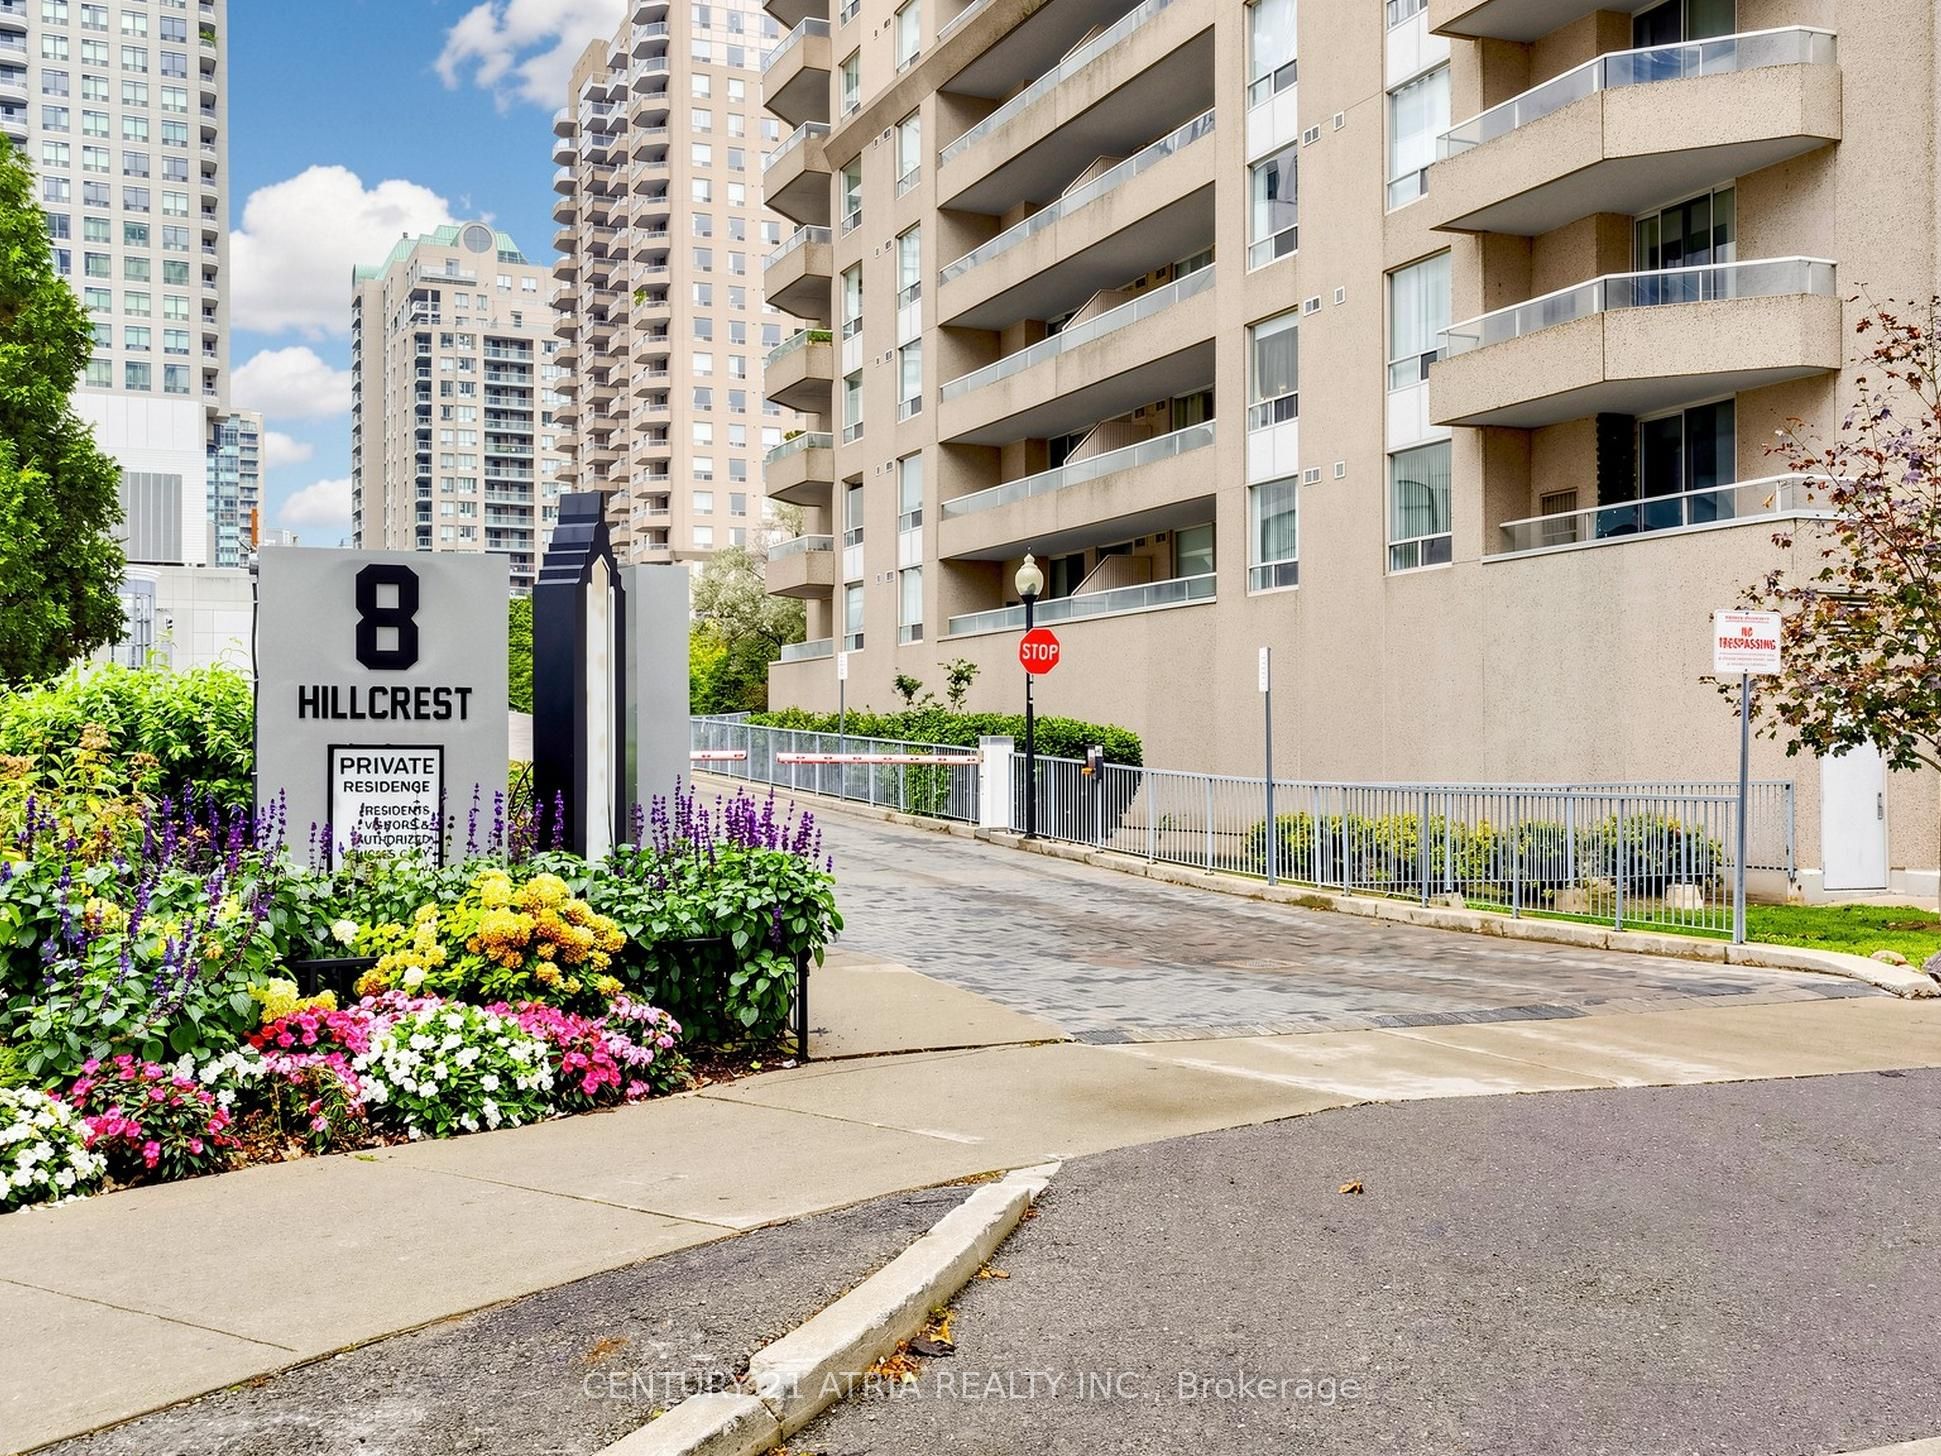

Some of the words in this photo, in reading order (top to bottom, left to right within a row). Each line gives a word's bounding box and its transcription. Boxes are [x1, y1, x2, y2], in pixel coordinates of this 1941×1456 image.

[356, 563, 420, 671] 8
[1741, 626, 1753, 638] NO
[1719, 637, 1777, 650] TRESPASSING
[1022, 643, 1059, 660] STOP
[298, 685, 473, 720] HILLCREST
[339, 756, 435, 774] PRIVATE
[343, 780, 430, 793] RESIDENCE
[365, 805, 430, 816] RESIDENTS
